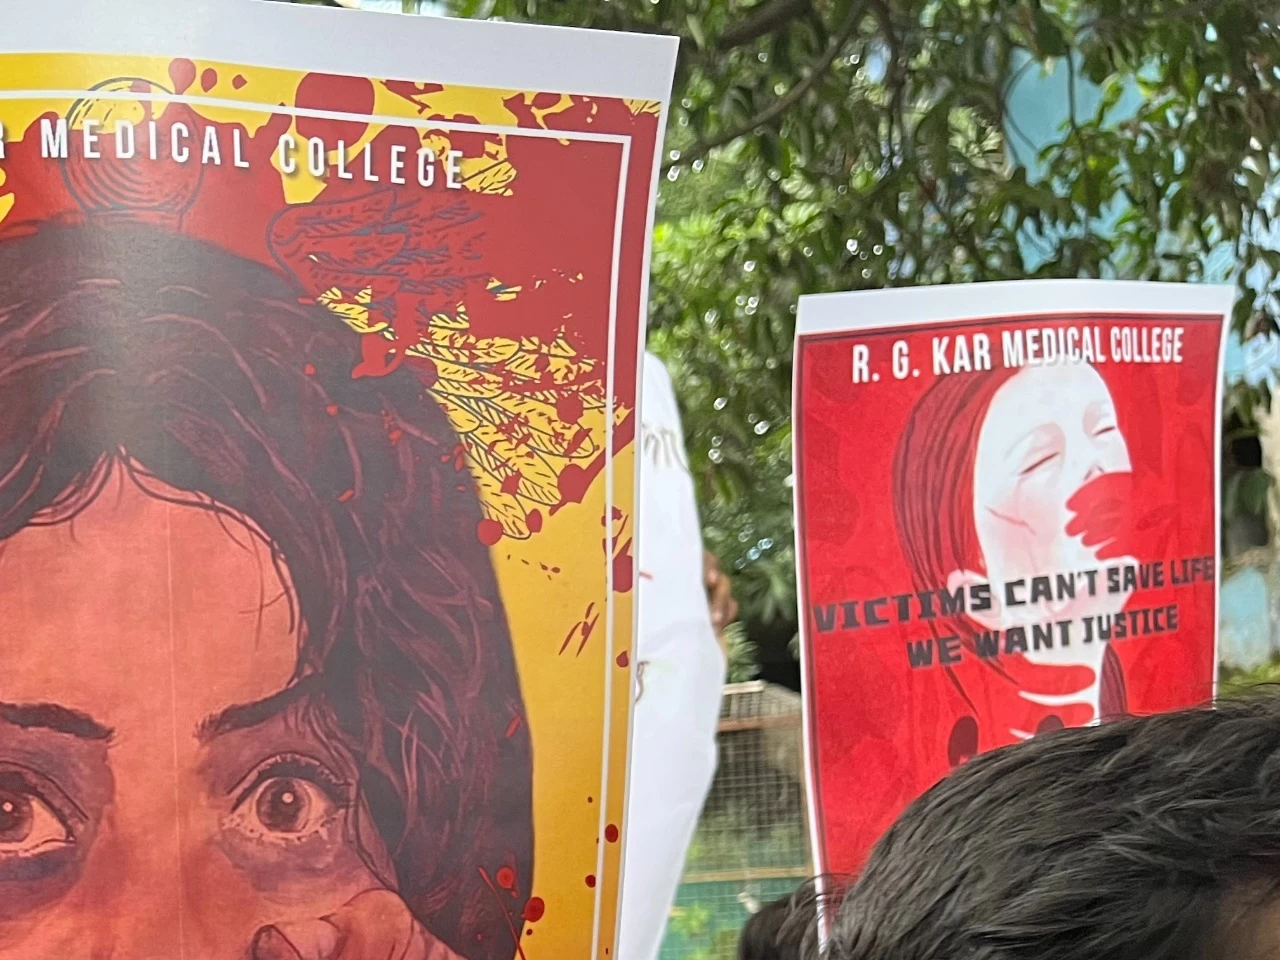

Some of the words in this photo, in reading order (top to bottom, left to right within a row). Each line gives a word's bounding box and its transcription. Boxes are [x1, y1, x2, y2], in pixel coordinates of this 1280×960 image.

[39, 118, 250, 168] MEDICAL
[278, 132, 463, 190] COLLEGE
[852, 343, 880, 384] R.
[891, 340, 920, 379] G.
[932, 332, 992, 375] KAR
[1001, 326, 1106, 369] MEDICAL
[1110, 326, 1184, 364] COLLEGE
[813, 583, 992, 633] VICTIMS
[1003, 569, 1099, 606] CAN'T
[1107, 562, 1165, 595] SAVE
[907, 636, 962, 669] WE
[973, 619, 1073, 658] WANT
[1081, 603, 1180, 644] JUSTICE
